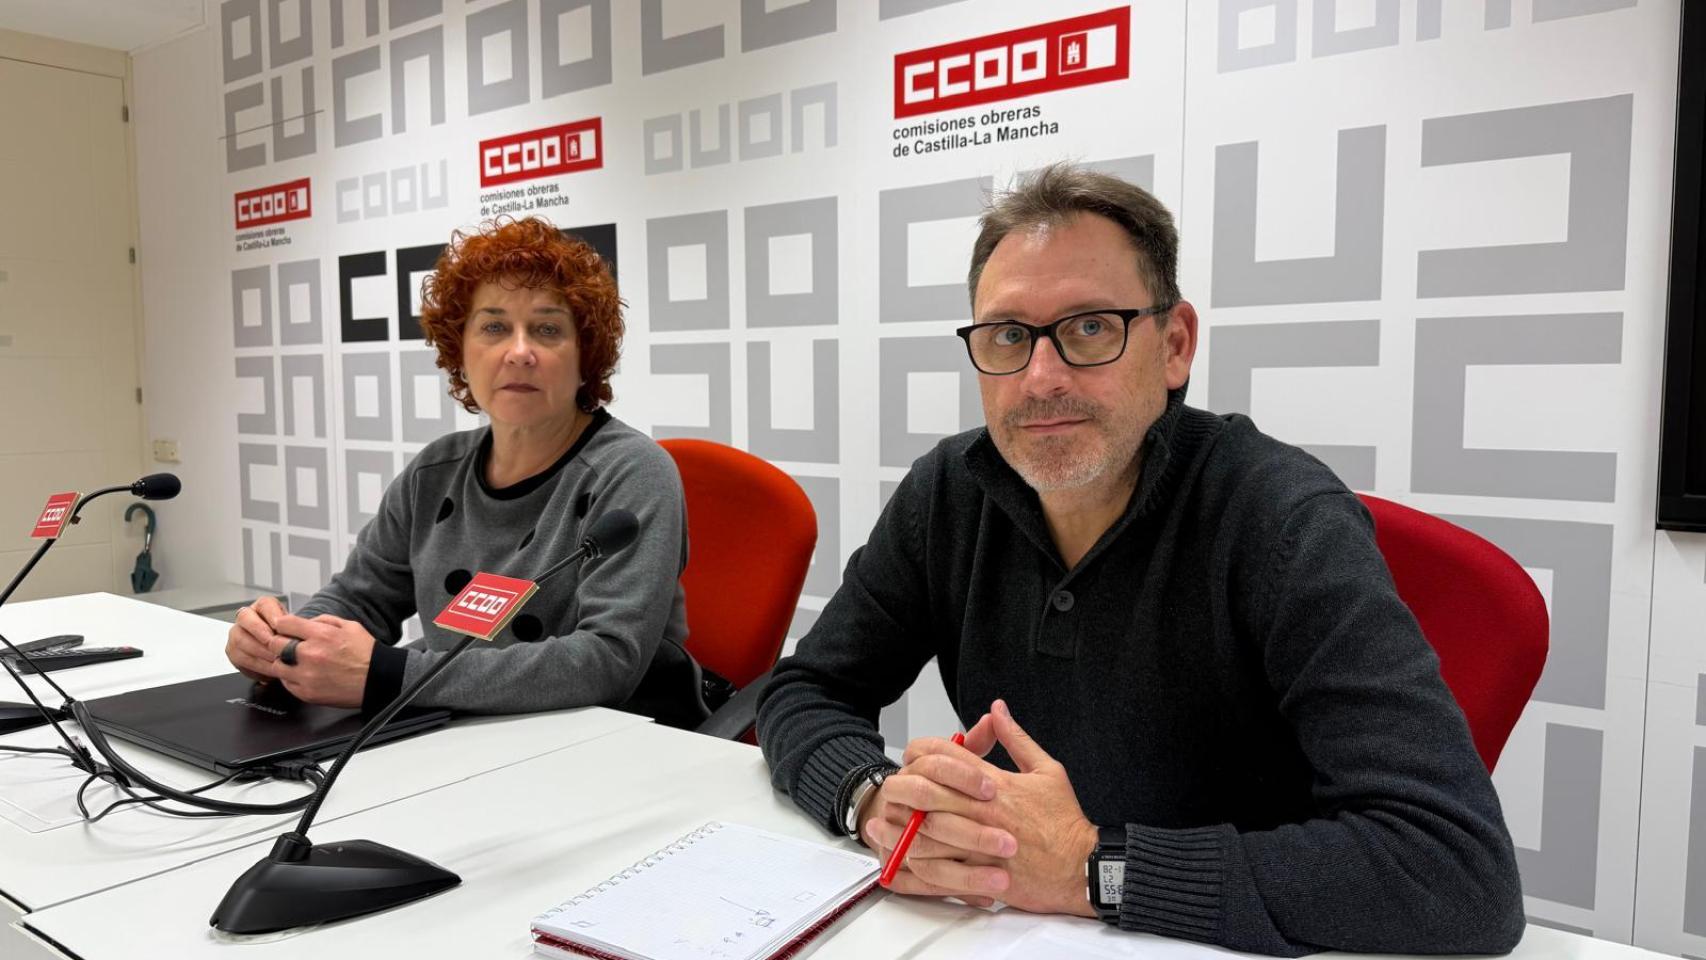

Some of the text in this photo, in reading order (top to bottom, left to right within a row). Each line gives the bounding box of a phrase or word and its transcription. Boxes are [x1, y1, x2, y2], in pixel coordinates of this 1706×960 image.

[904, 37, 1047, 105] CCOO
[893, 105, 1041, 140] comisiones obreras
[893, 121, 1059, 158] de Castilla-La Mancha
[484, 135, 561, 177] CCOO
[238, 191, 287, 222] CCOO
[480, 183, 559, 203] comisiones obreras
[480, 195, 569, 216] de Castilla-La Mancha
[42, 507, 66, 522] CCOO
[457, 590, 509, 615] CCOO
